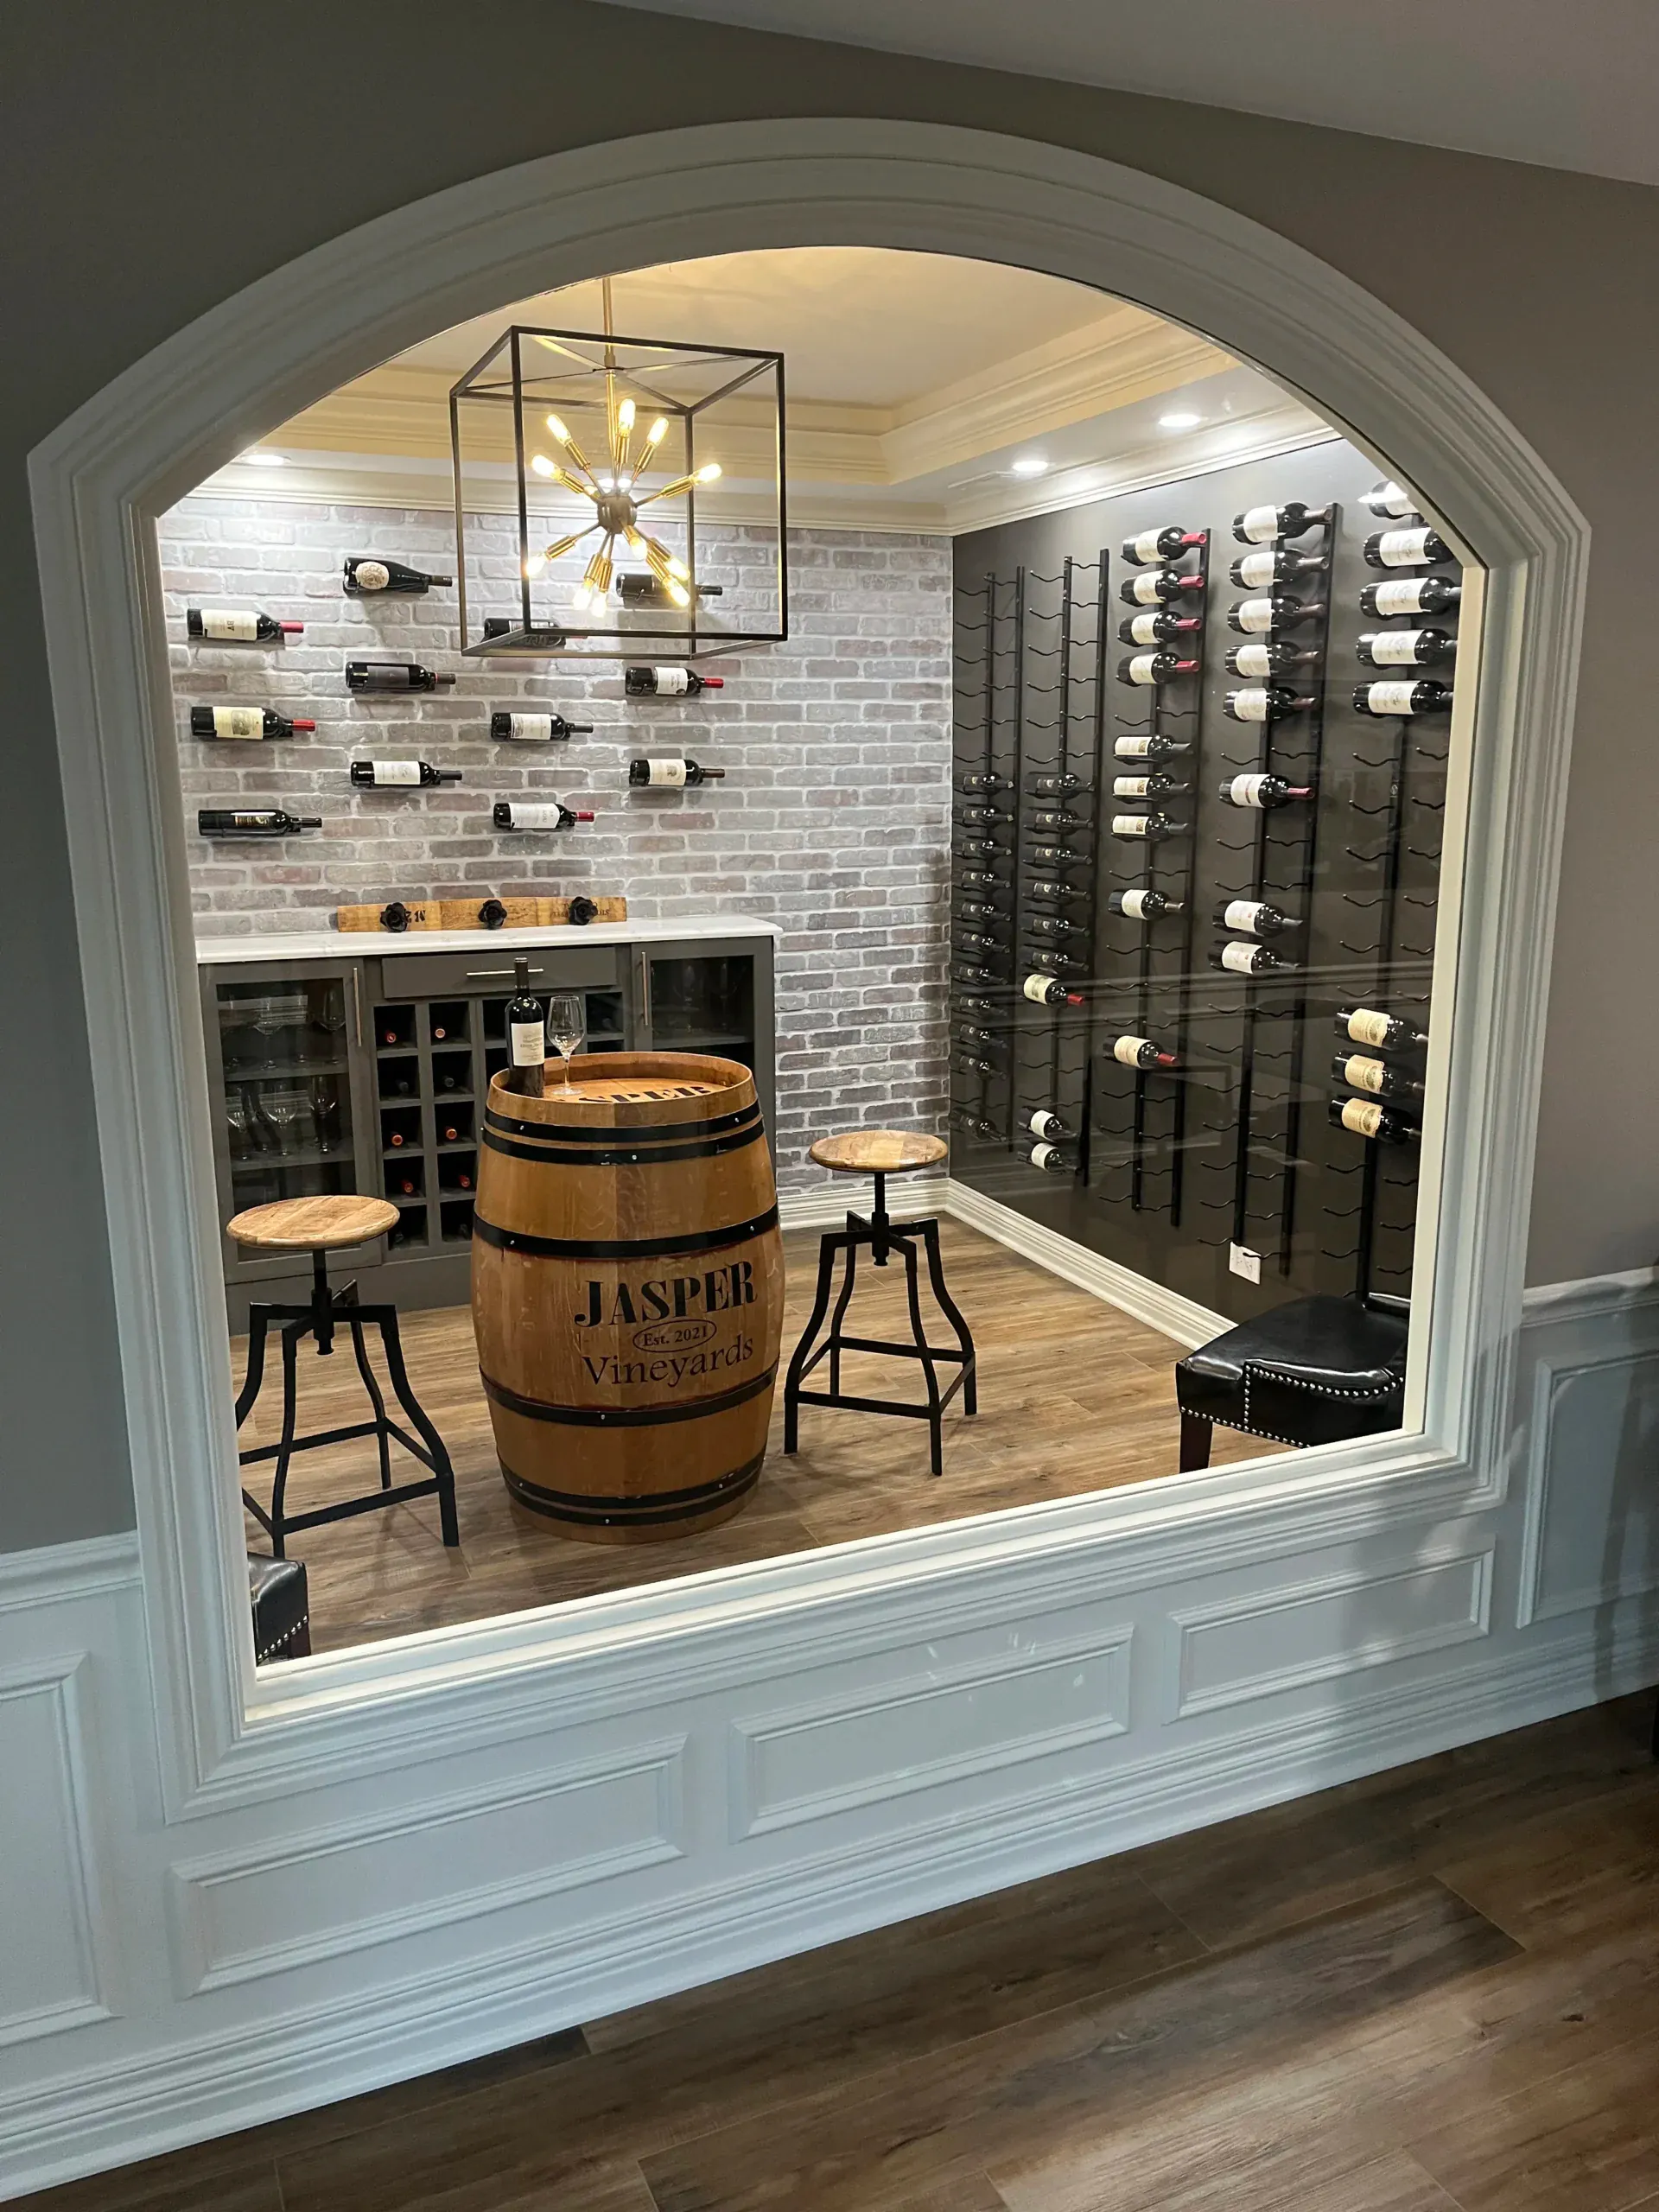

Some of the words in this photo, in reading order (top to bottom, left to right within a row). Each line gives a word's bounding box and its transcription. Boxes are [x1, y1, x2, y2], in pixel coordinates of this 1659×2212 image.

[574, 1261, 759, 1328] JASPER
[582, 1334, 753, 1388] Vineyards
[642, 1332, 670, 1347] Est.
[675, 1326, 709, 1344] 2021
